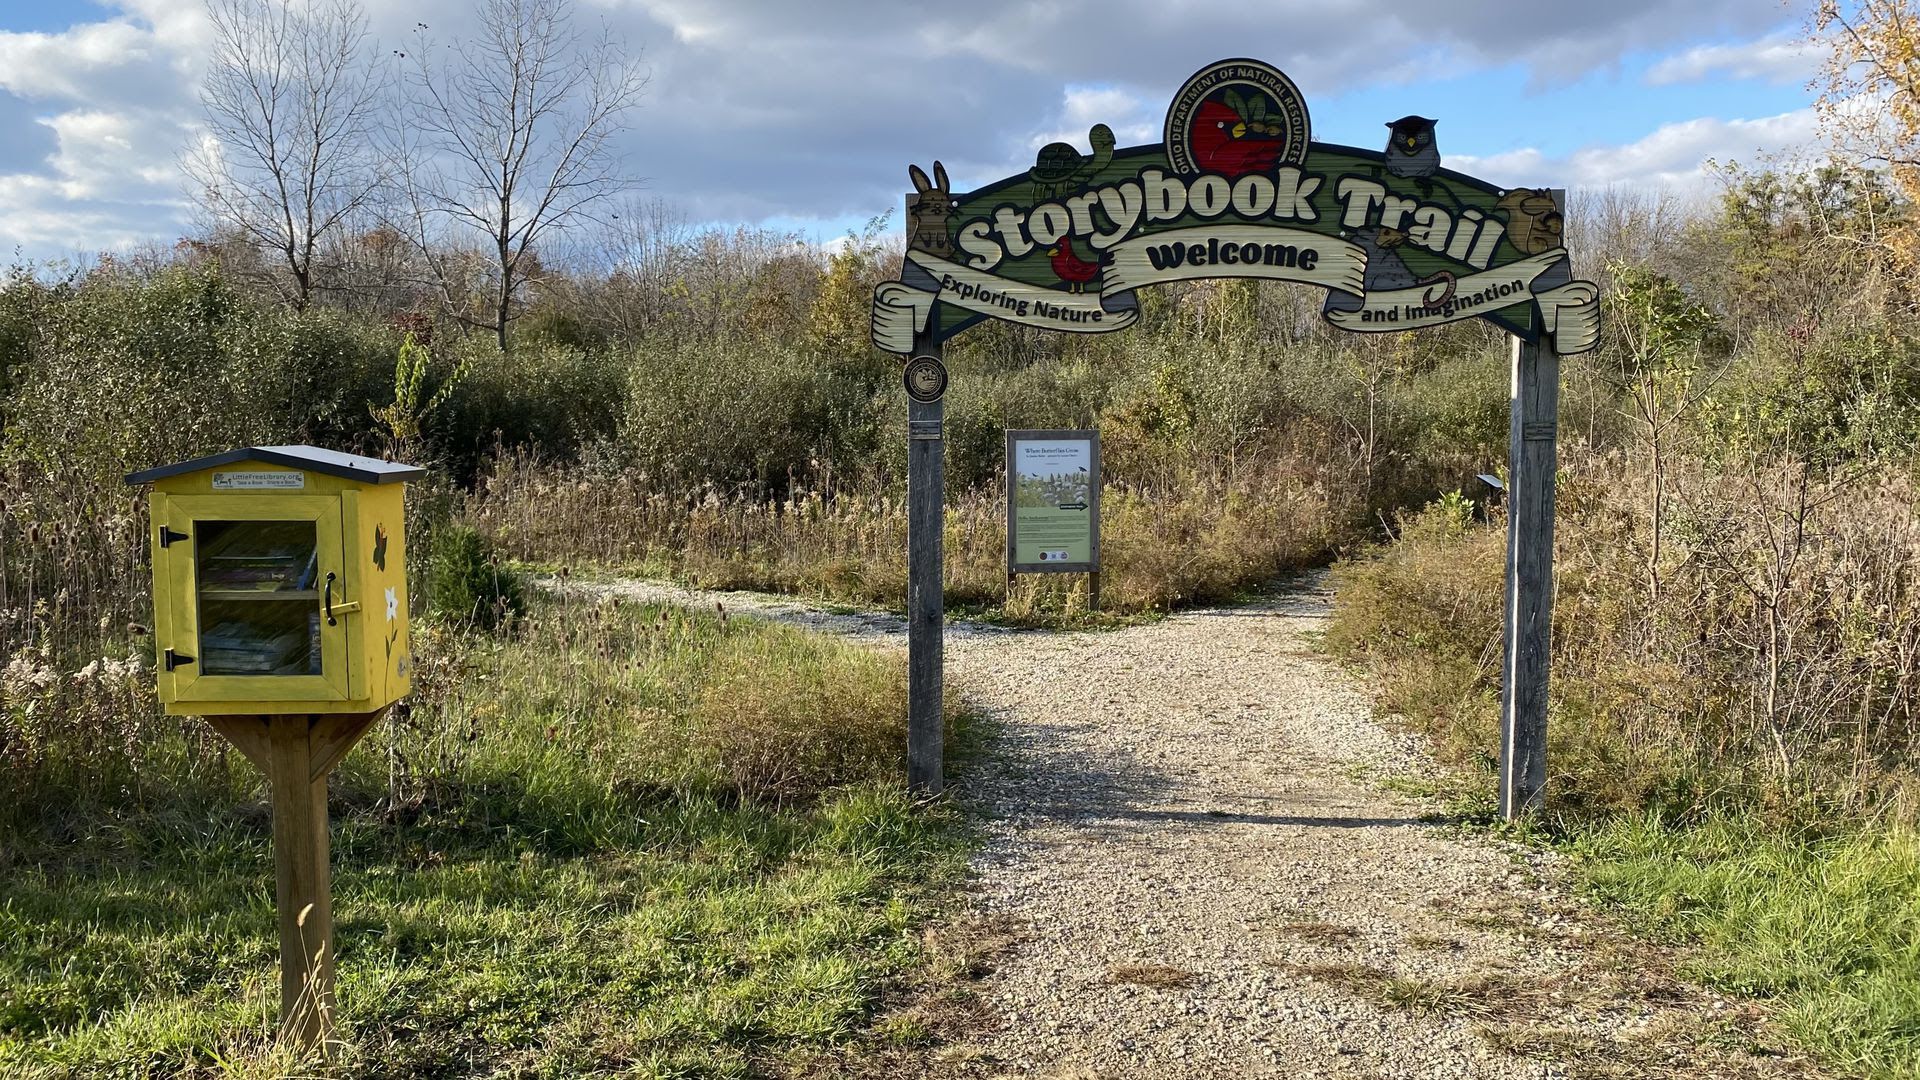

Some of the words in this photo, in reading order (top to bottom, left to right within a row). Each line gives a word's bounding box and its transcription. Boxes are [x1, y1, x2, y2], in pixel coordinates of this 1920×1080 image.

[1219, 67, 1235, 79] OF
[1237, 67, 1285, 98] NATURAL
[1172, 73, 1216, 141] DEPARTMENT
[1284, 96, 1302, 163] RESOURCES
[1173, 145, 1190, 174] OHIO
[958, 166, 1323, 271] Storybook
[1337, 177, 1506, 270] Trail
[941, 273, 1029, 317] Exploring
[1033, 300, 1103, 323] Nature
[1361, 305, 1399, 322] and
